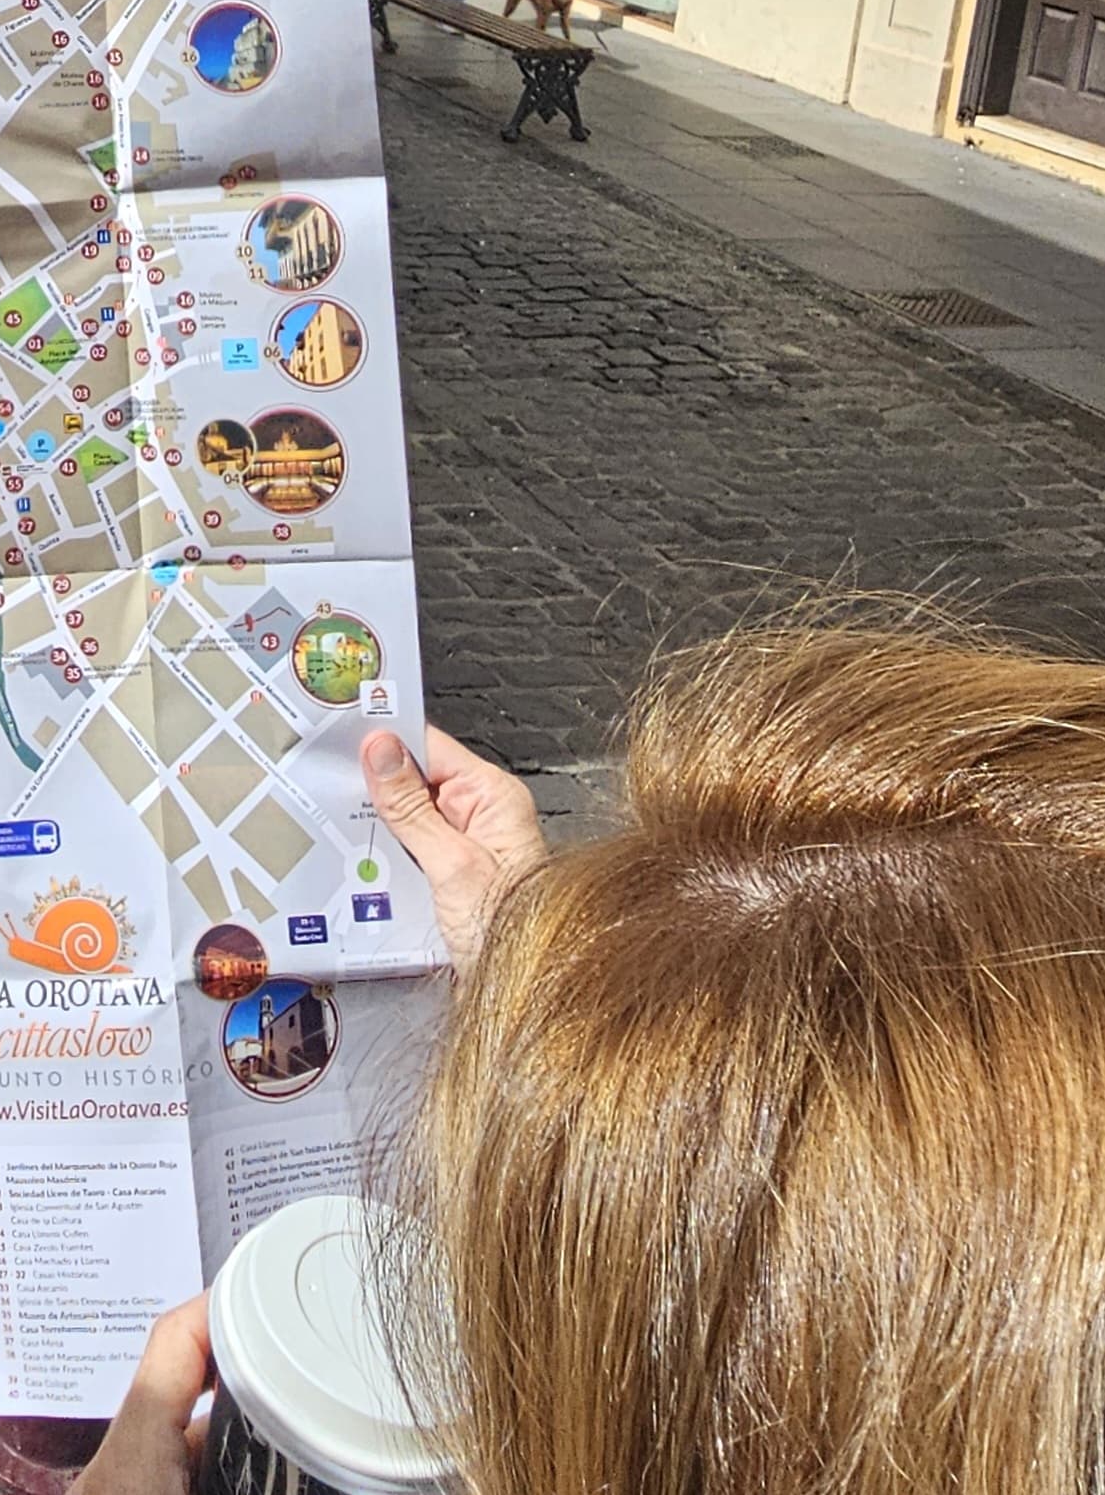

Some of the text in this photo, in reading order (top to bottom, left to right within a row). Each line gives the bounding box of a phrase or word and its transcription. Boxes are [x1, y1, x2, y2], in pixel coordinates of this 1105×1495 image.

[53, 34, 68, 45] 16
[109, 52, 122, 63] 15
[182, 51, 197, 63] 16
[88, 73, 103, 84] 16
[135, 150, 149, 162] 14
[91, 198, 106, 209] 13
[118, 232, 130, 243] 11
[237, 246, 252, 257] 10
[250, 268, 264, 279] 11
[179, 294, 194, 305] 16
[4, 314, 20, 325] 45
[180, 322, 195, 333] 16
[28, 339, 42, 350] 01
[236, 343, 244, 352] P
[91, 346, 106, 358] 02
[136, 351, 150, 362] 05
[163, 351, 177, 362] 06
[264, 347, 280, 358] 06
[74, 388, 88, 399] 03
[37, 439, 45, 448] P
[166, 452, 181, 463] 40
[61, 461, 76, 473] 41
[7, 478, 23, 490] 55
[223, 473, 240, 485] 04
[19, 521, 35, 532] 27
[54, 579, 70, 590] 29
[67, 613, 82, 625] 37
[82, 640, 97, 652] 36
[262, 636, 278, 648] 43
[52, 651, 67, 662] 34
[66, 668, 82, 680] 35
[24, 977, 166, 1011] OROTAVA
[84, 1061, 213, 1088] HISTÓRICO
[112, 1187, 132, 1197] Casa
